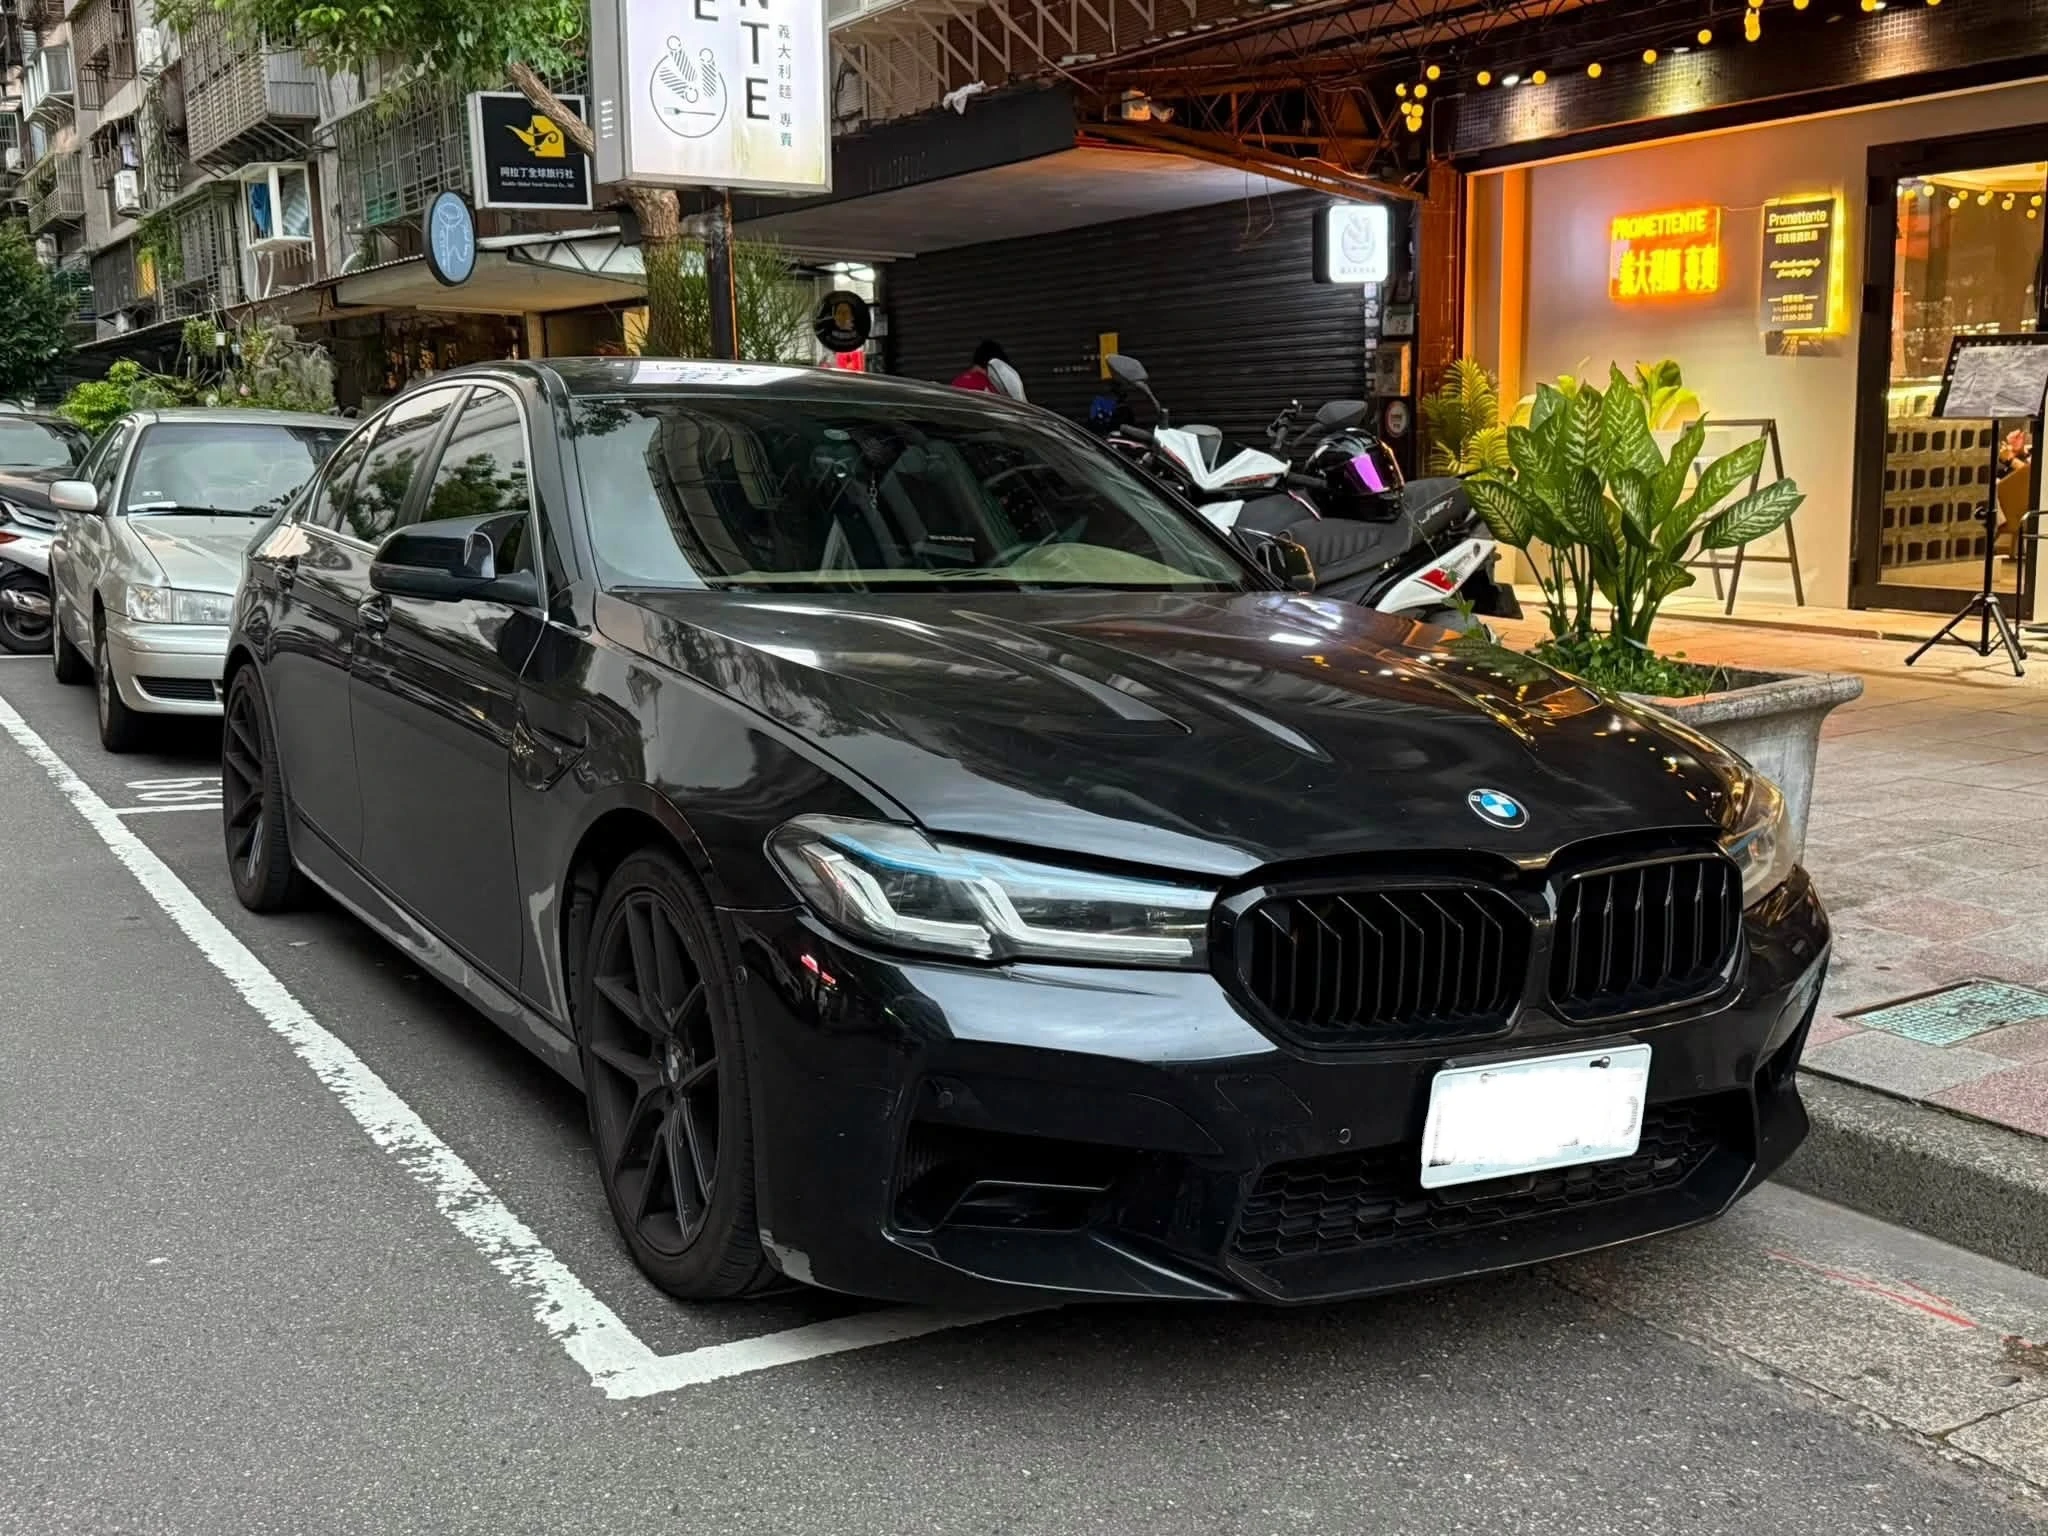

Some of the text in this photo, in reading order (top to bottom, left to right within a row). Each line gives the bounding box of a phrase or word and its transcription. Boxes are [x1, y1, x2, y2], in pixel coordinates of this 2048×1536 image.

[740, 0, 770, 120] TE
[500, 166, 575, 179] 阿拉丁全球旅行社
[1768, 209, 1827, 227] Promettente
